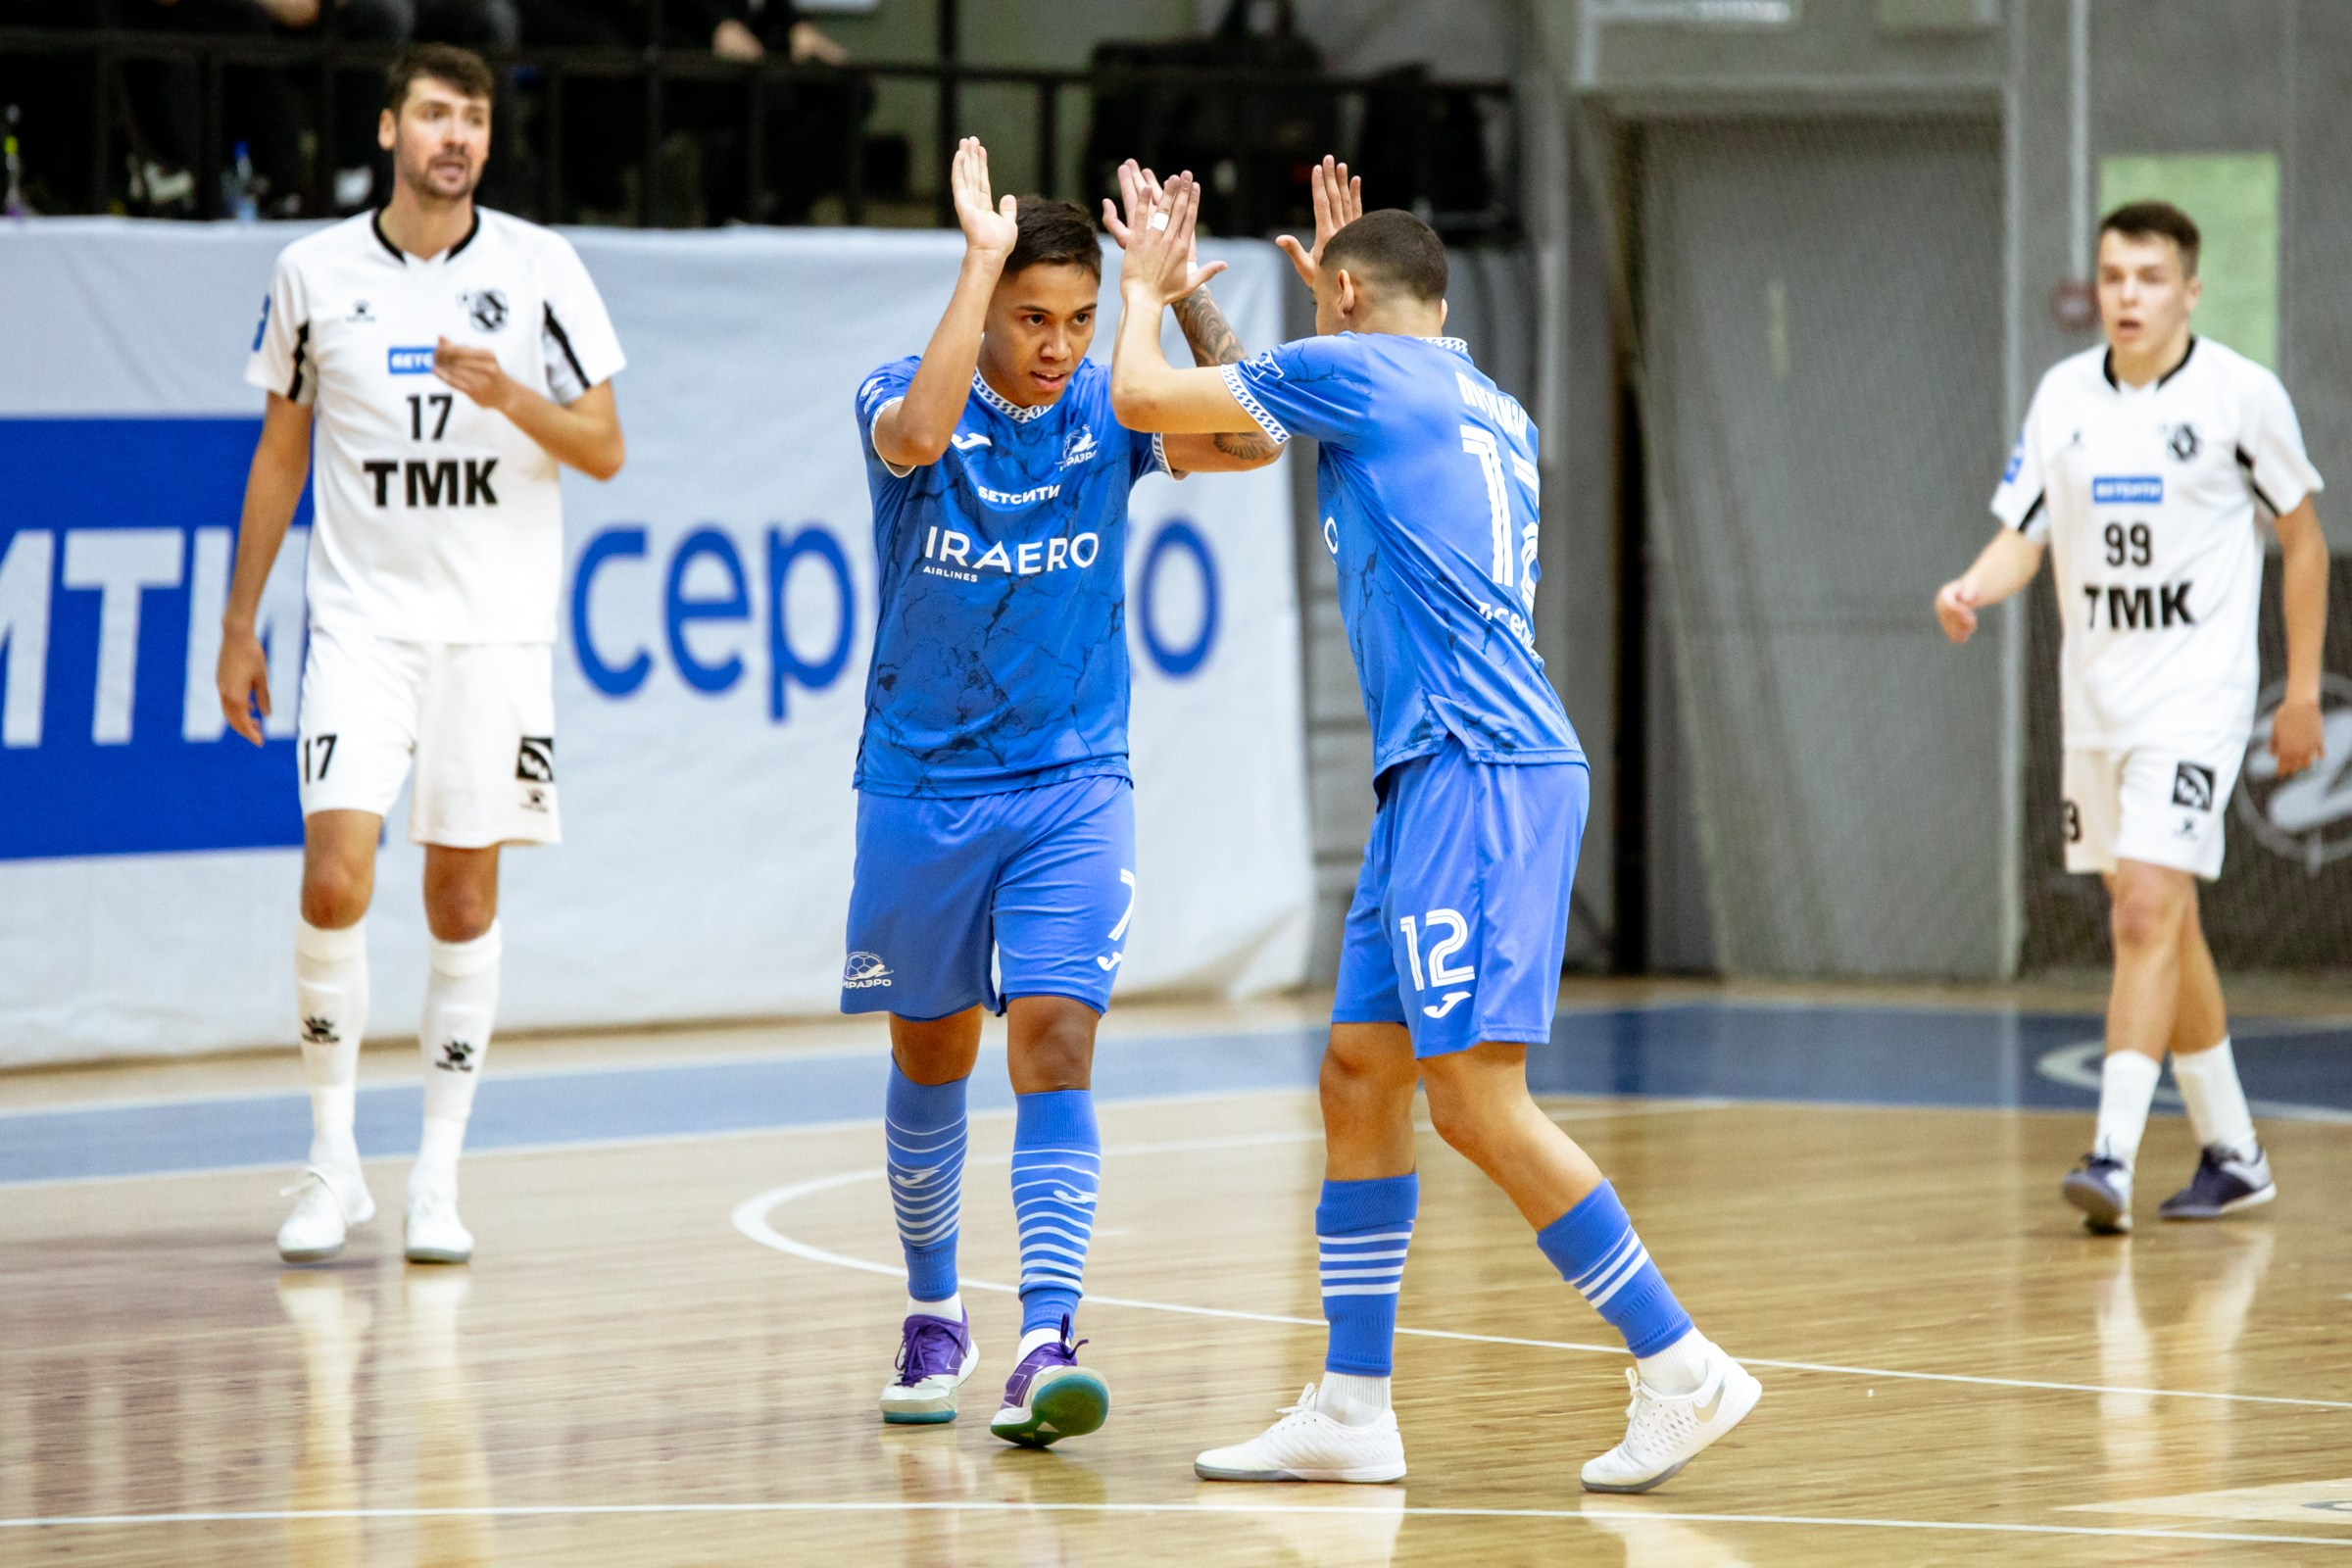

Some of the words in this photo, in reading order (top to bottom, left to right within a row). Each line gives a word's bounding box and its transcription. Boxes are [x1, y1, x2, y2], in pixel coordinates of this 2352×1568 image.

[408, 394, 453, 440] 17
[978, 484, 1060, 505] БЕТСИТИ
[924, 525, 1100, 575] IRAERO
[2105, 522, 2152, 567] 99
[923, 565, 978, 583] AIRLINES
[304, 733, 338, 784] 17
[1106, 868, 1135, 942] 7
[1399, 907, 1476, 991] 12
